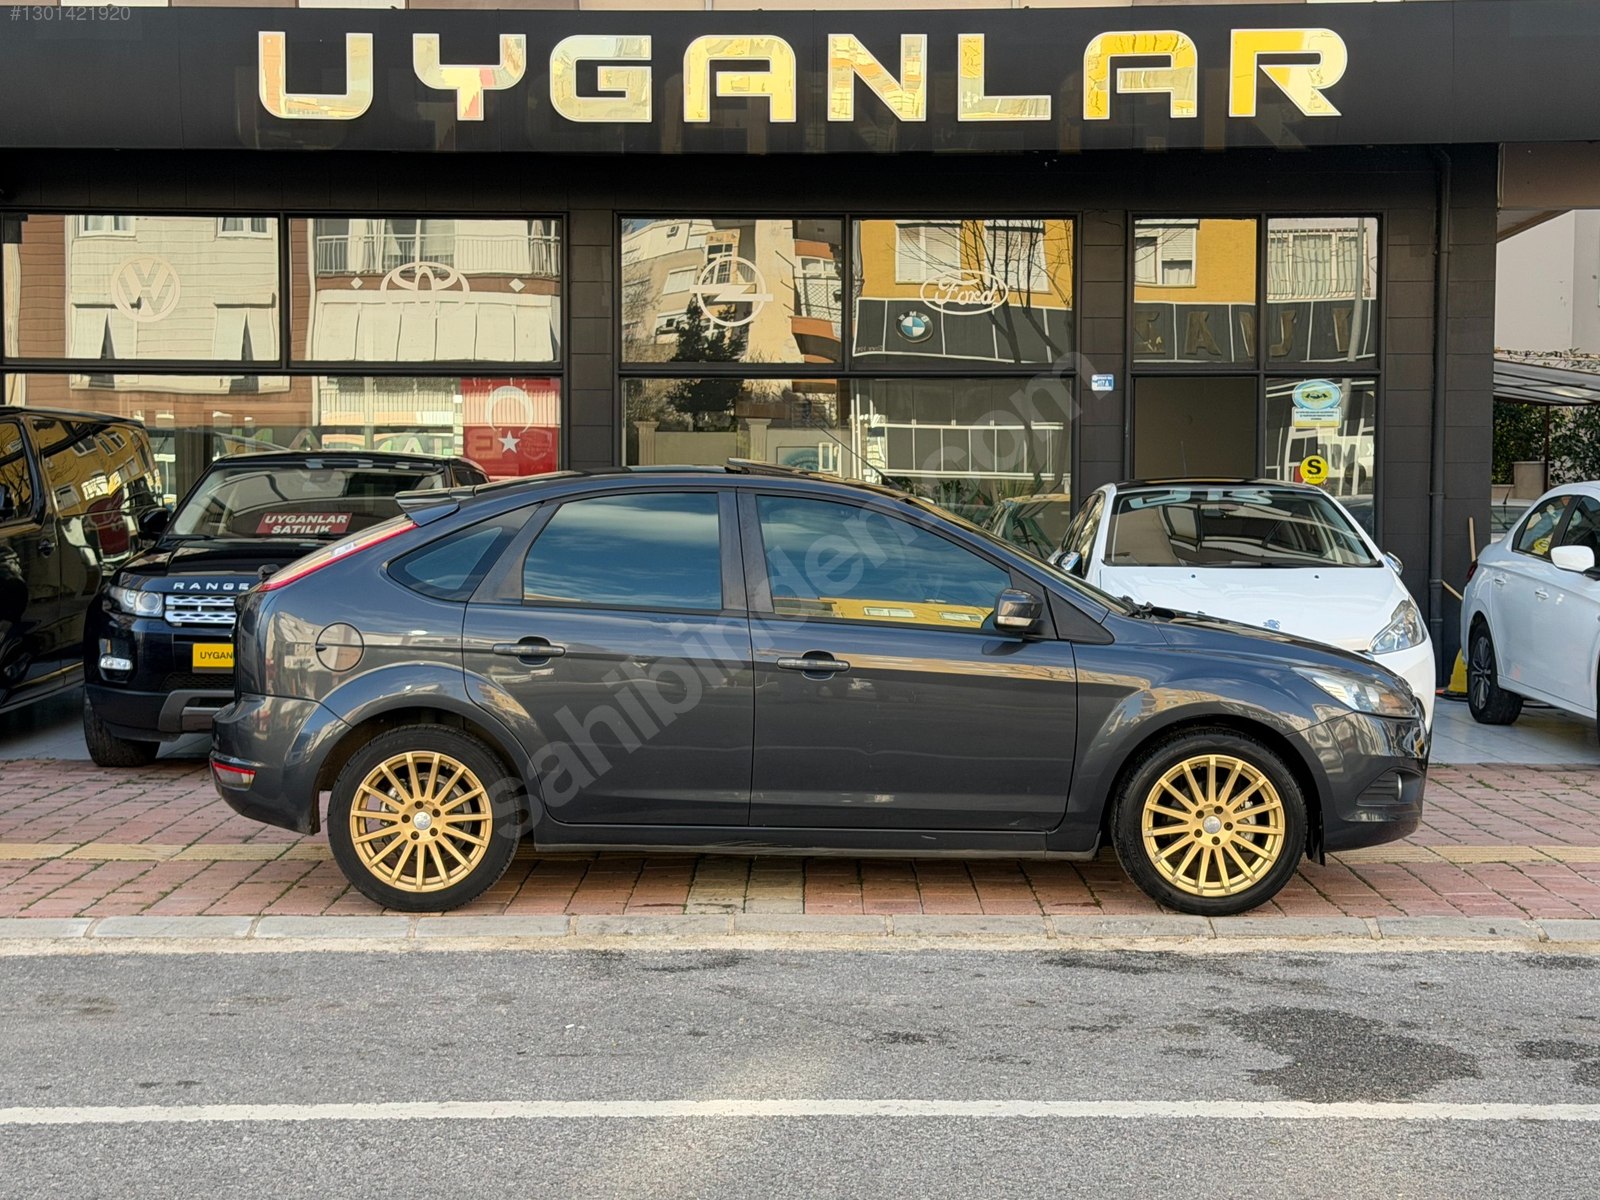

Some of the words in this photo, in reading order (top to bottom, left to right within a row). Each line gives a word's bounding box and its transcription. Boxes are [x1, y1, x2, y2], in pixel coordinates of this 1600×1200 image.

[257, 28, 1349, 123] UYGANLAR
[934, 278, 998, 305] Ford
[1307, 459, 1322, 476] S
[264, 515, 348, 524] UYGANLAR
[271, 525, 332, 534] SATILIK
[173, 582, 250, 591] RANGE
